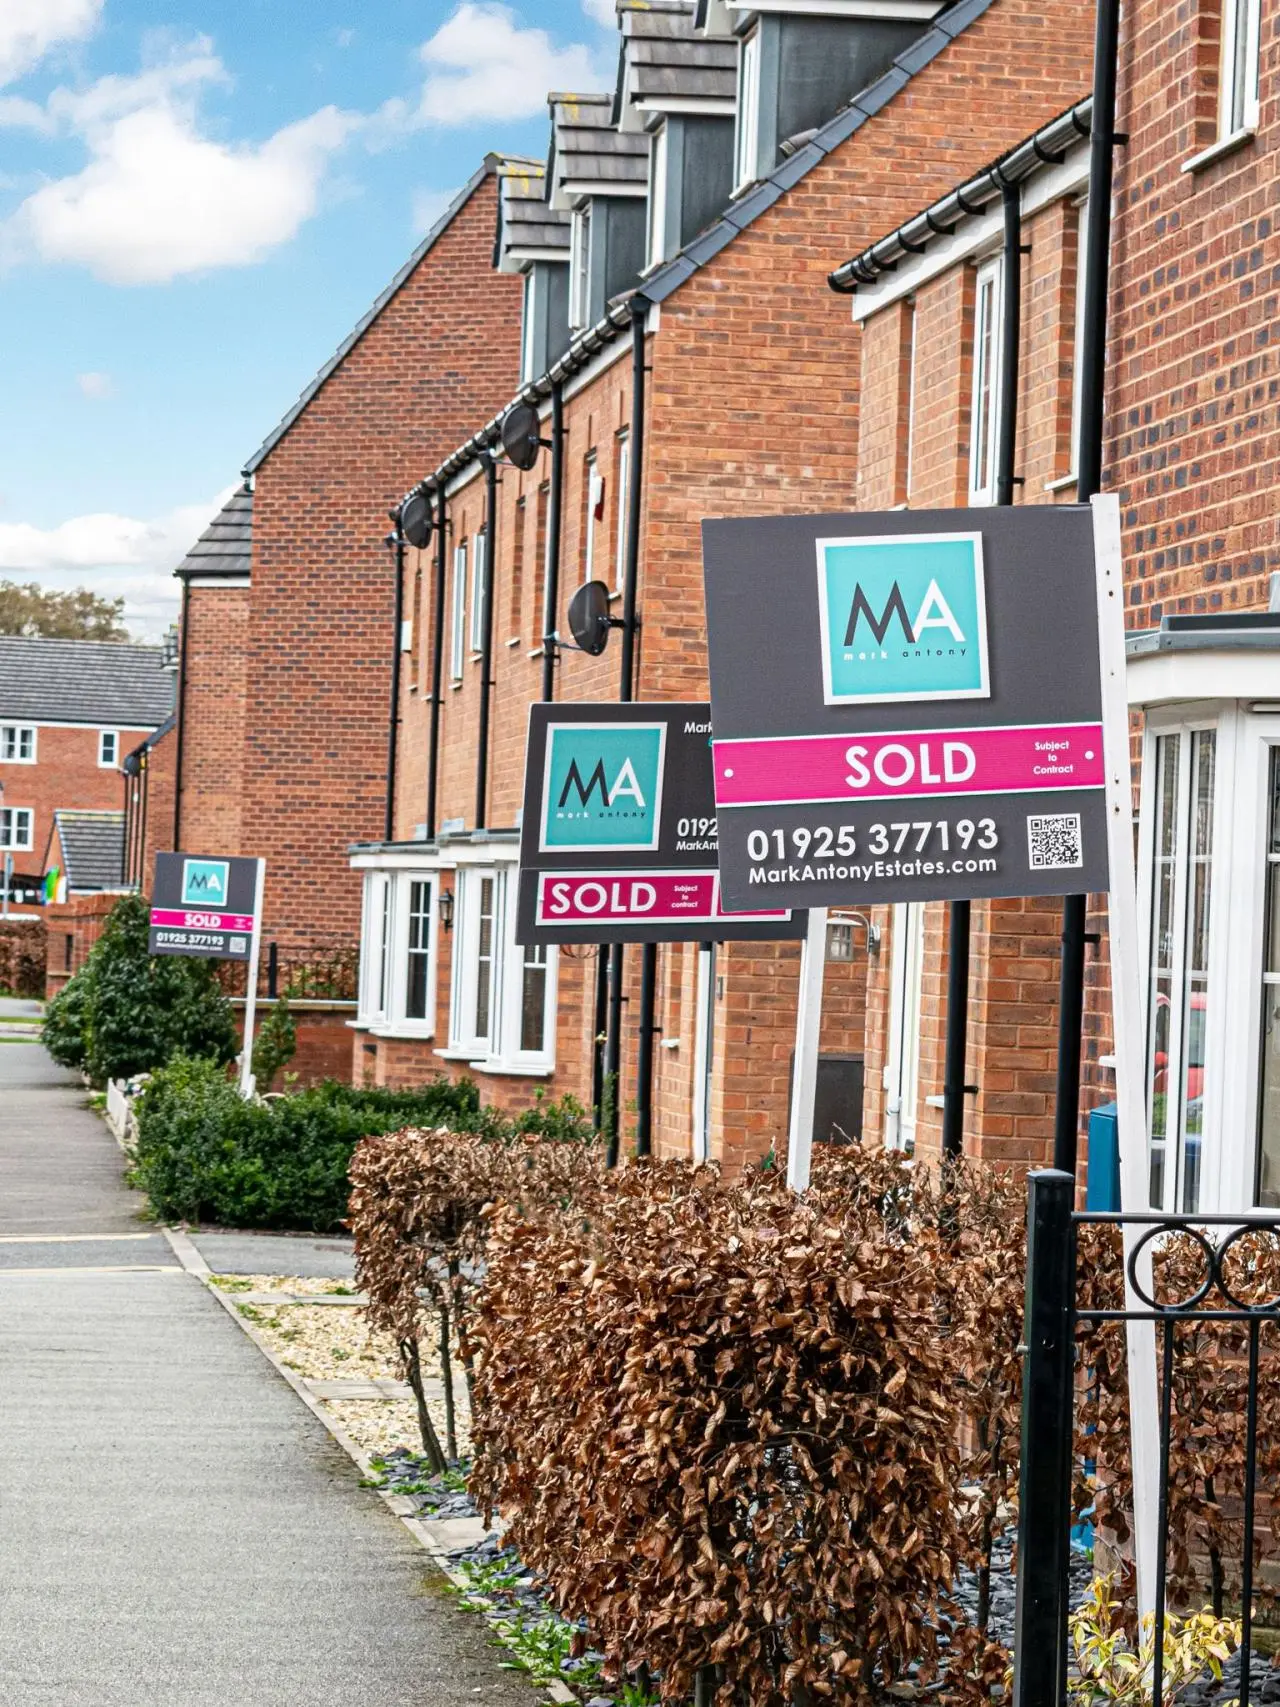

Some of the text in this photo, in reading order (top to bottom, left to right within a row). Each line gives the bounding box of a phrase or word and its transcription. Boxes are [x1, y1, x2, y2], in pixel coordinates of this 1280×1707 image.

[844, 579, 965, 646] MA
[844, 647, 966, 661] mark antony
[1034, 740, 1070, 754] Subject
[845, 741, 976, 789] SOLD
[1047, 753, 1058, 763] to
[1033, 764, 1074, 775] Contract
[558, 757, 646, 808] MA
[556, 810, 646, 820] mark antony
[747, 818, 999, 863] 01925 377193
[748, 855, 998, 885] MarkAntonyEstates.com
[189, 873, 222, 891] MA
[674, 884, 698, 894] Subject
[550, 882, 657, 914] SOLD
[681, 893, 689, 901] to
[671, 900, 698, 909] contract
[184, 913, 221, 928] SOLD
[156, 932, 224, 945] 01925 377193
